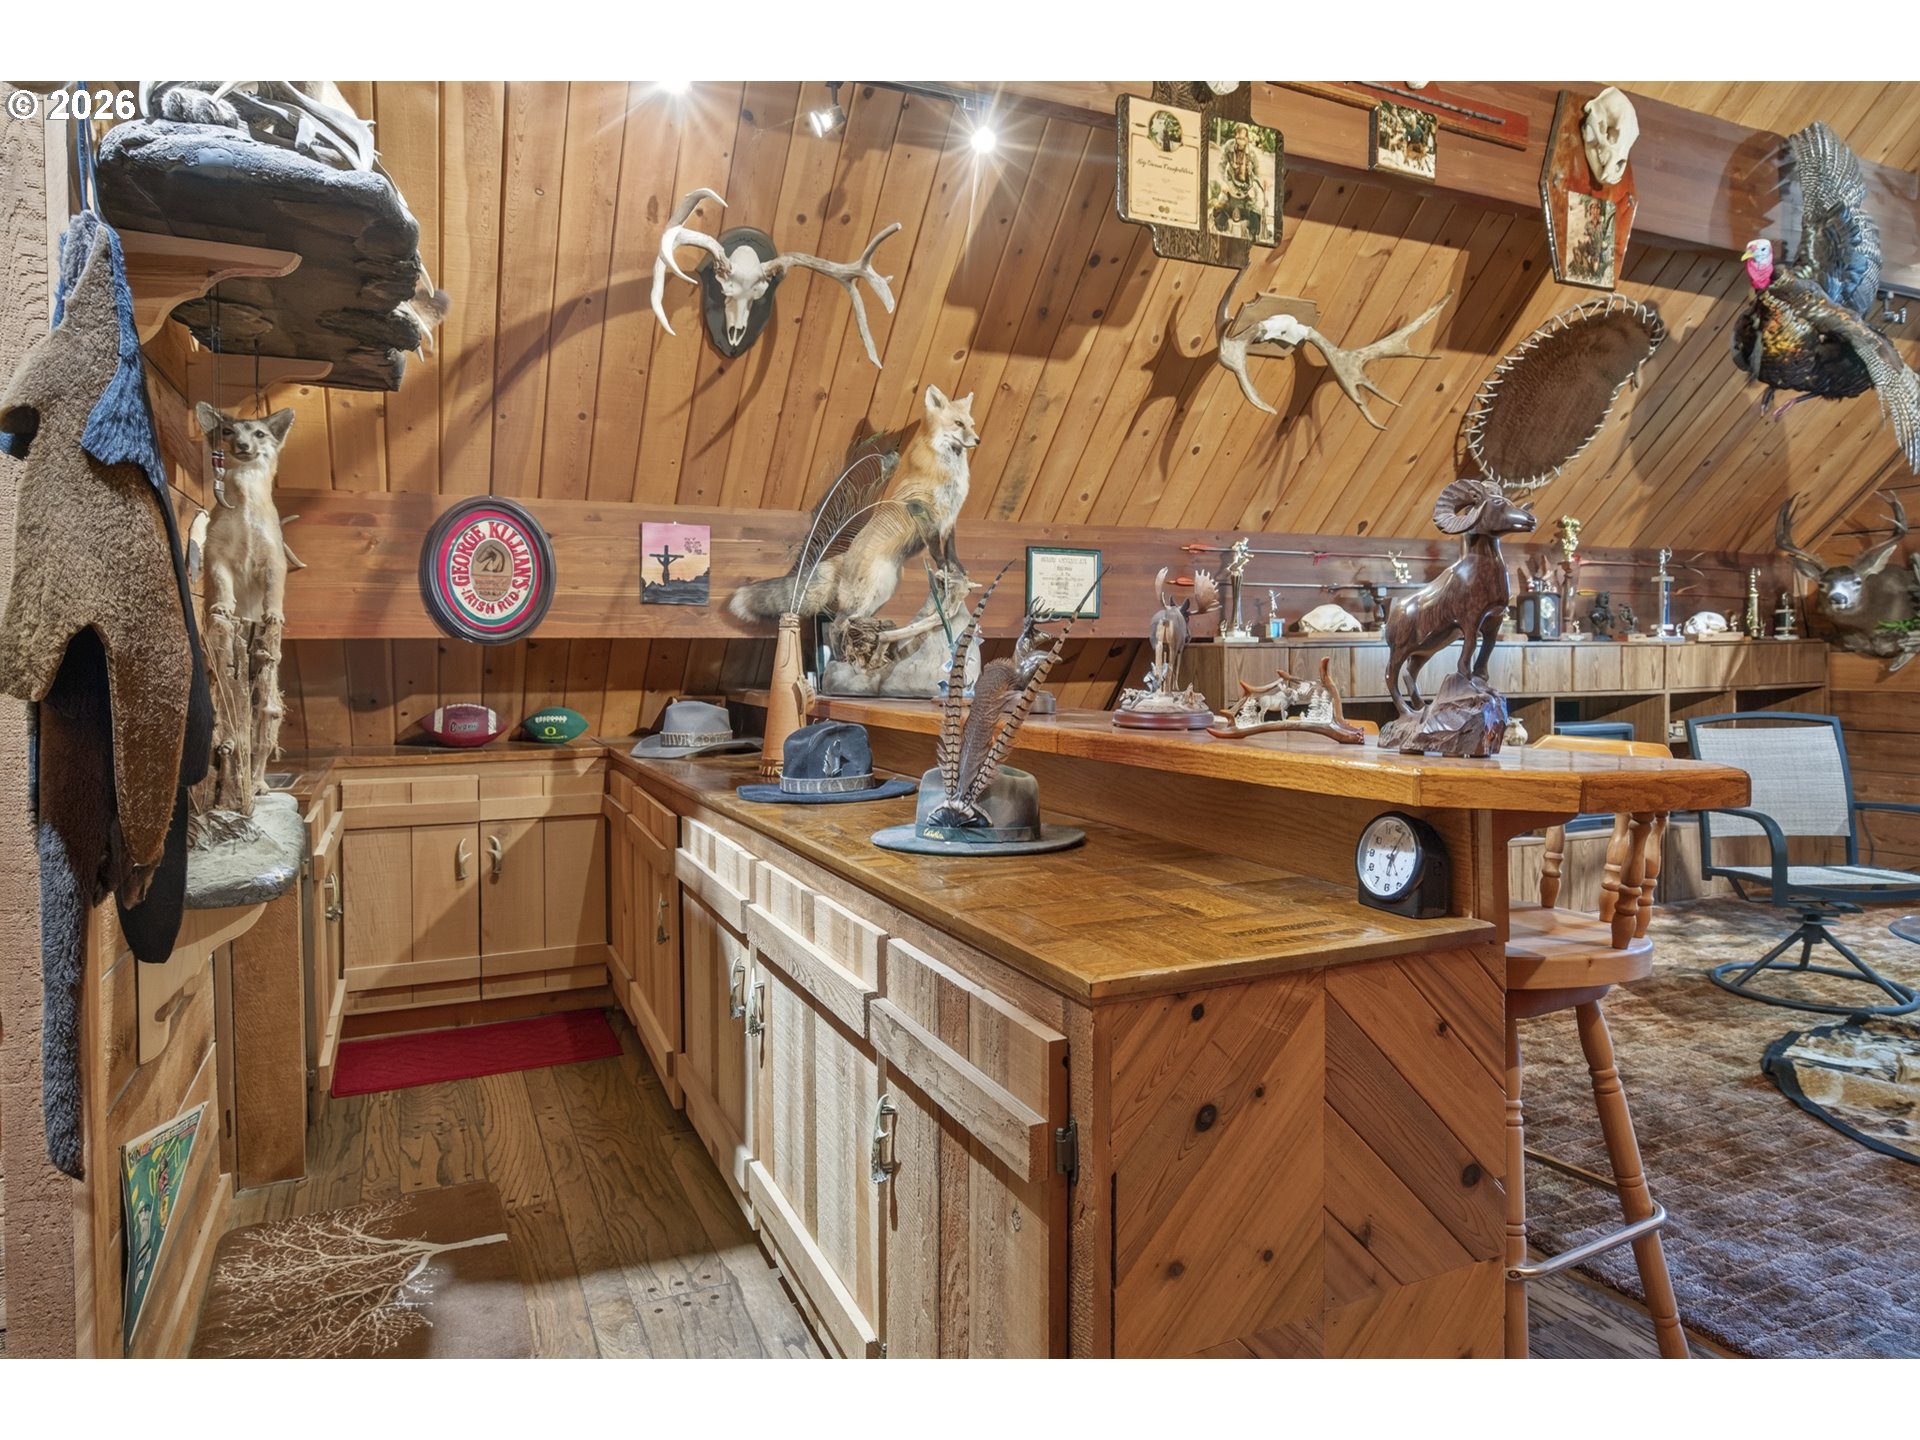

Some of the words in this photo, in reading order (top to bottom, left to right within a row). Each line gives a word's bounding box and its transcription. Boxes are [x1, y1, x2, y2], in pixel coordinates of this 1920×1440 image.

[452, 525, 486, 587] GEORGE
[488, 521, 532, 591] KILLIAN'S
[461, 589, 495, 614] IRISH
[497, 591, 520, 612] RED
